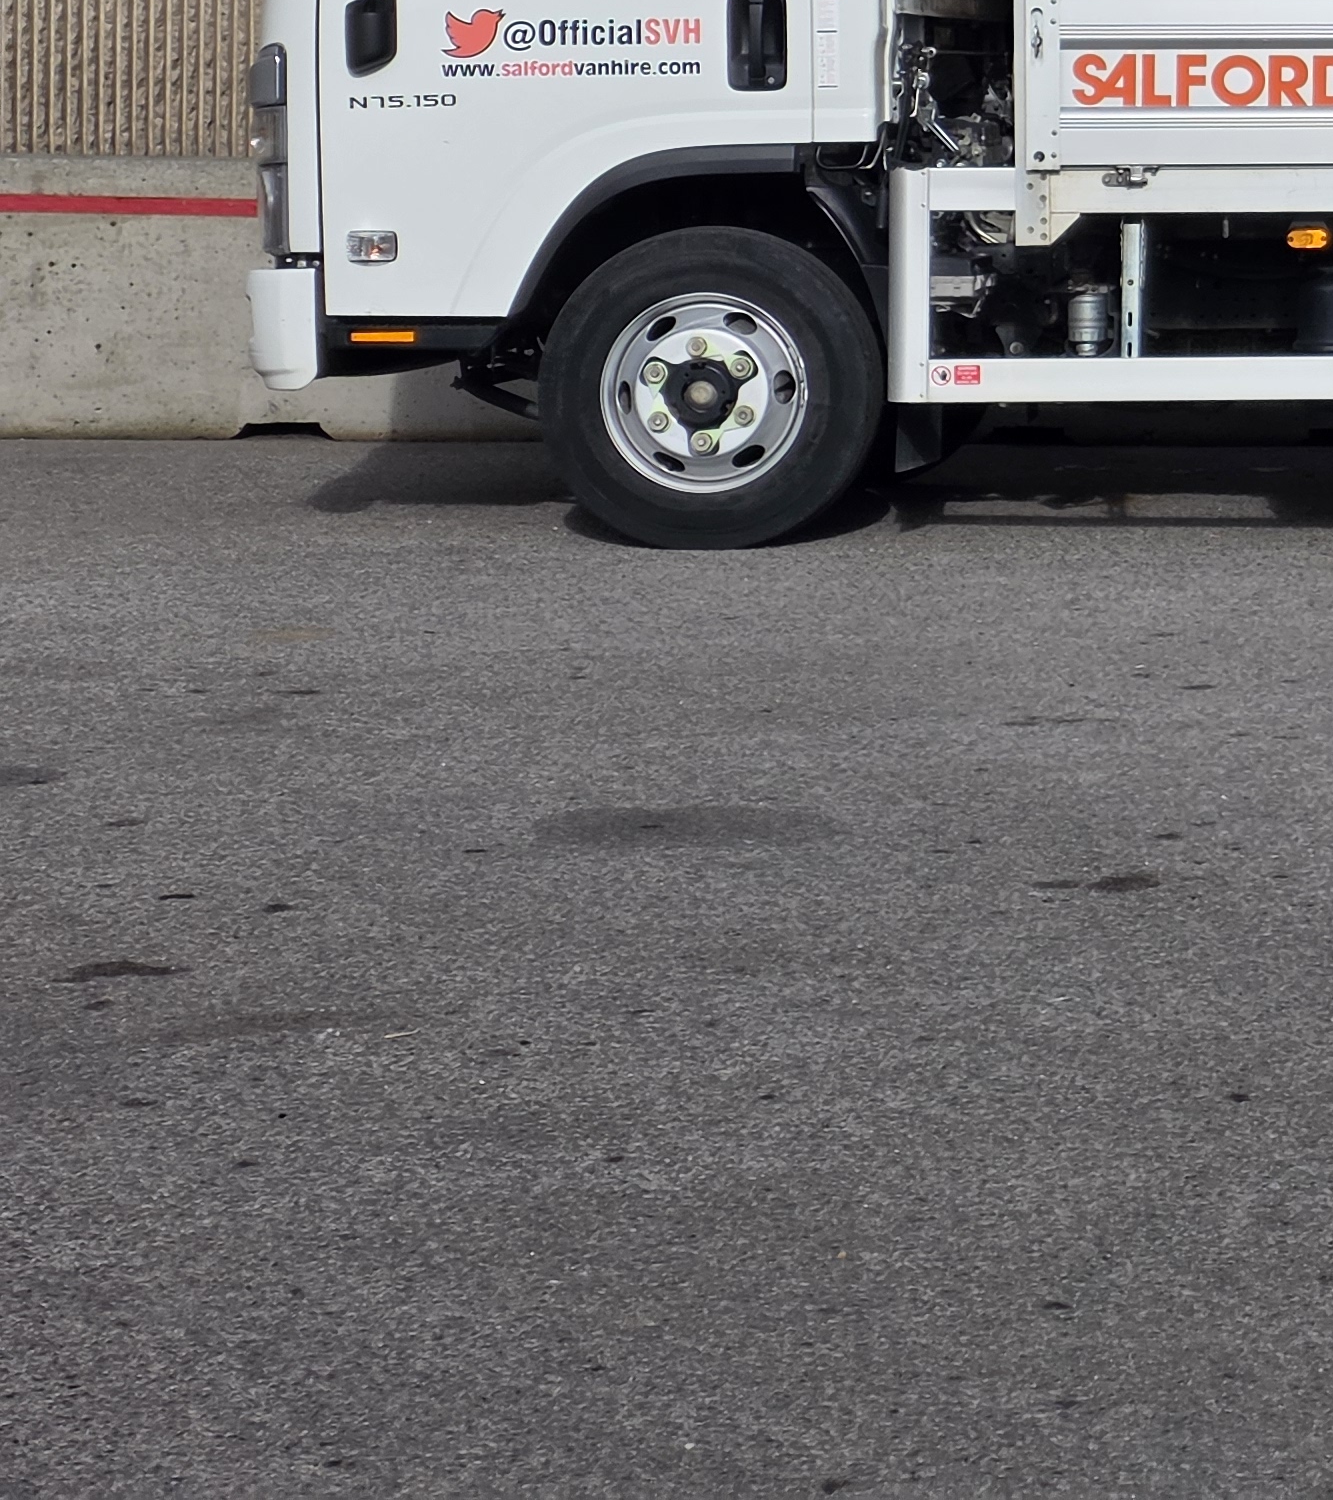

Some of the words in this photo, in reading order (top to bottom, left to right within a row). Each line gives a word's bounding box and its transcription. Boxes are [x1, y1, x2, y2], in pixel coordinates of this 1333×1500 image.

[503, 17, 701, 51] @OfficialSVH
[441, 59, 701, 78] www.salfordvanhire.com
[349, 93, 457, 109] N75.150
